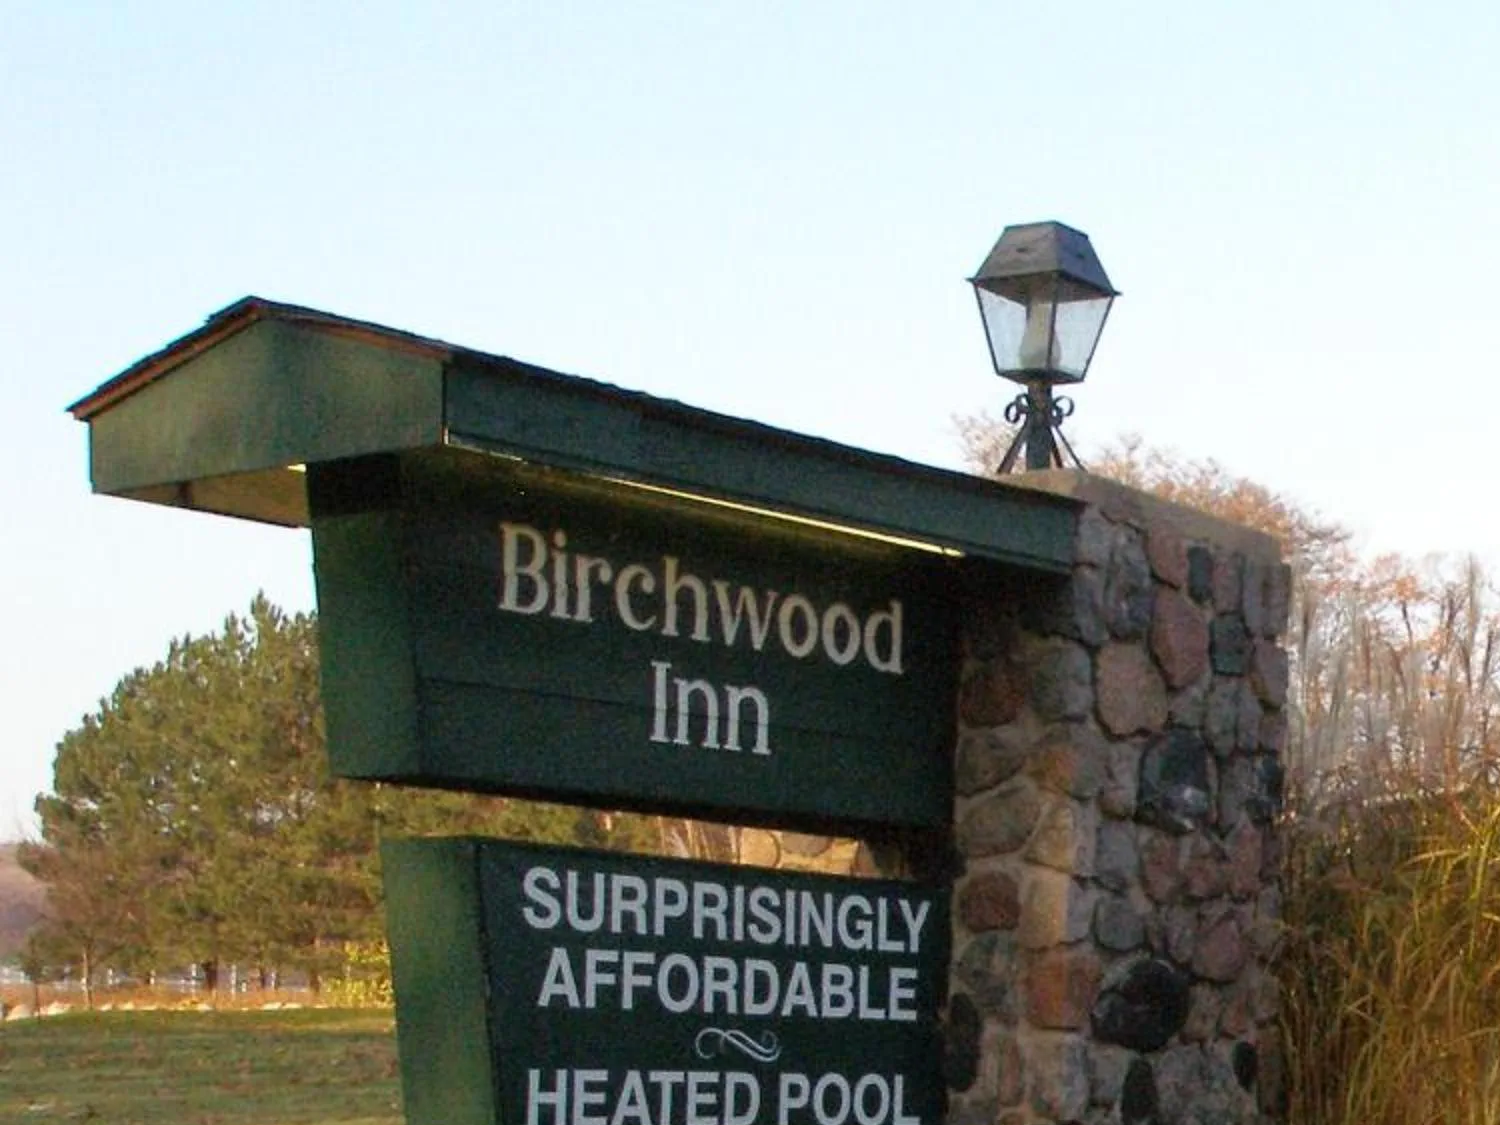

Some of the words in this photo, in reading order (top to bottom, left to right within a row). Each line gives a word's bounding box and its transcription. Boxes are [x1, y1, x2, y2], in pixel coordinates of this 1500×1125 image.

[499, 524, 903, 673] Birchwood
[650, 662, 771, 754] Inn
[521, 867, 931, 953] SURPRISINGLY
[537, 948, 919, 1021] AFFORDABLE
